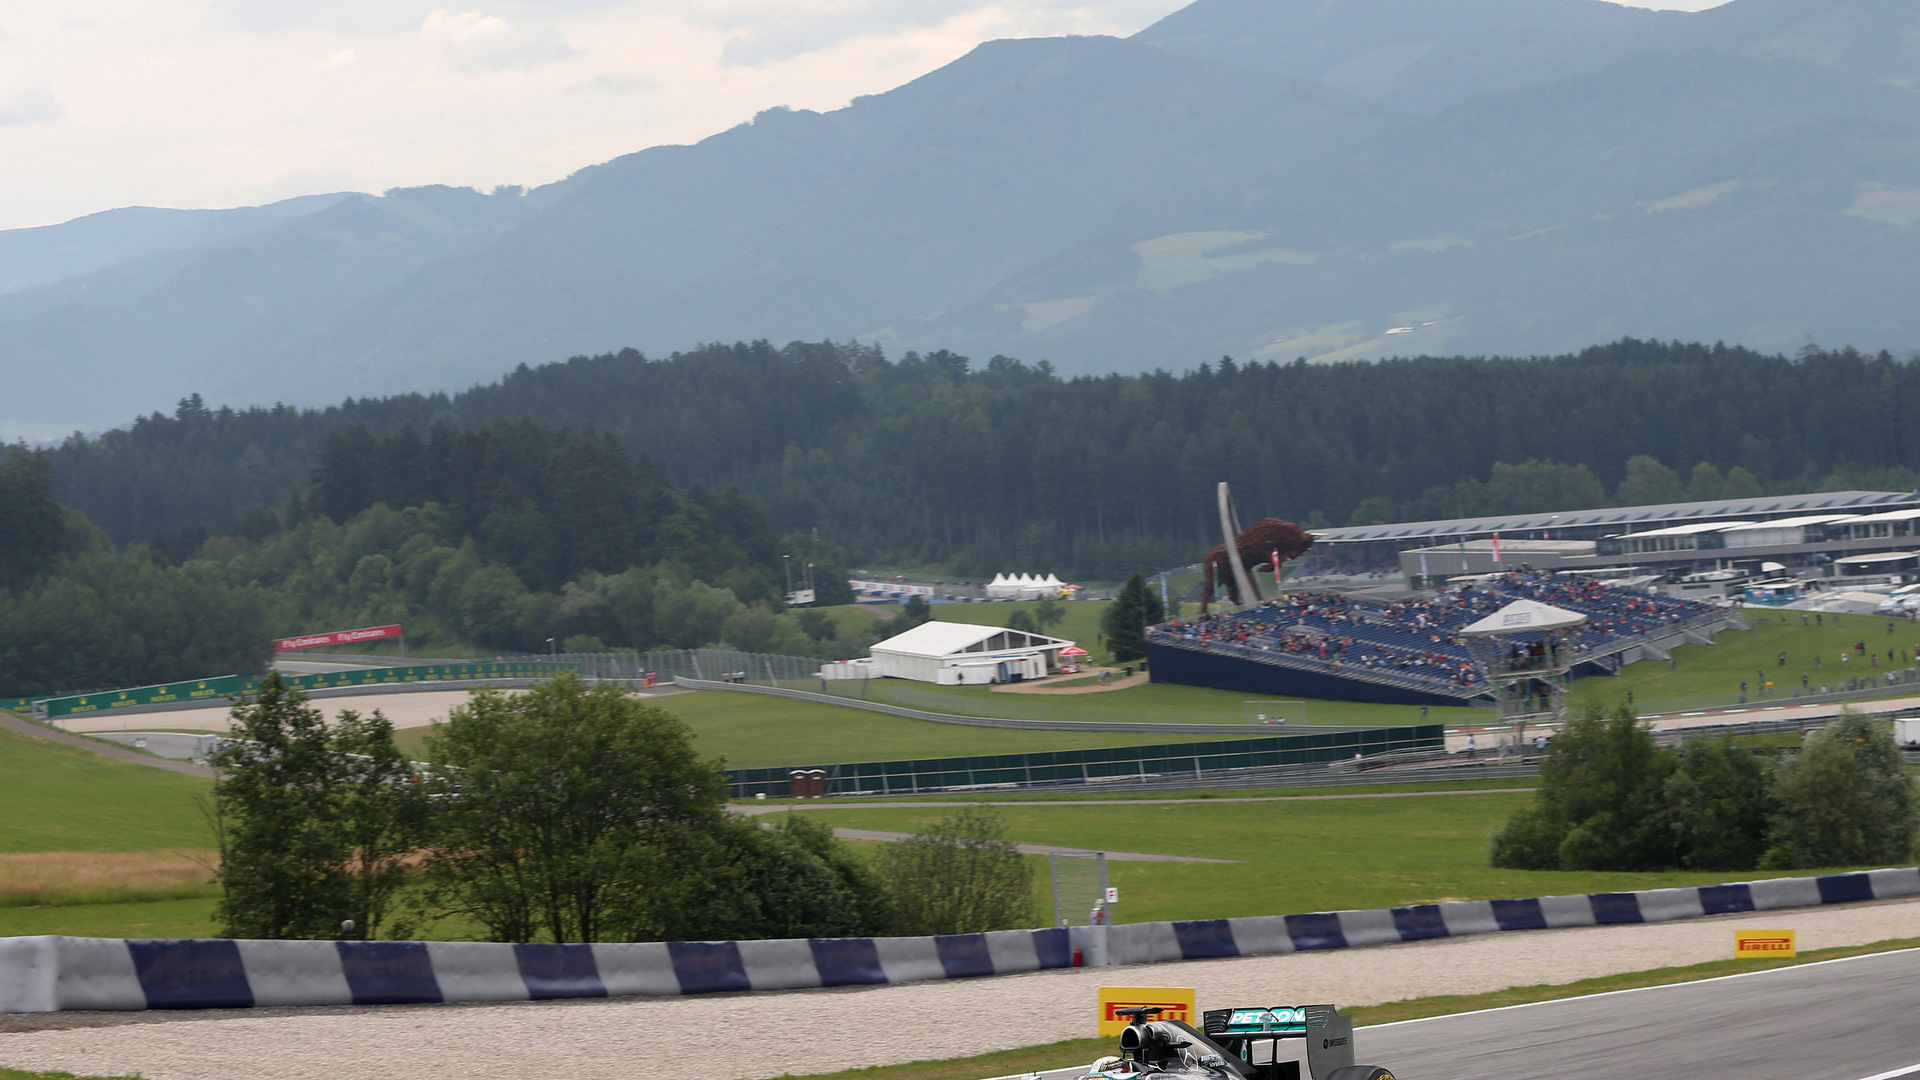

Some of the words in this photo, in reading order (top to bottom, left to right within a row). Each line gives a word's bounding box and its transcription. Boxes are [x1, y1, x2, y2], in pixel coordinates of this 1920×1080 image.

[282, 640, 296, 648] Fly
[297, 636, 330, 647] Emirates
[338, 633, 351, 641] Fly
[351, 629, 385, 640] Emirates
[1739, 938, 1790, 951] PIRELLI
[1230, 1010, 1306, 1024] PETON
